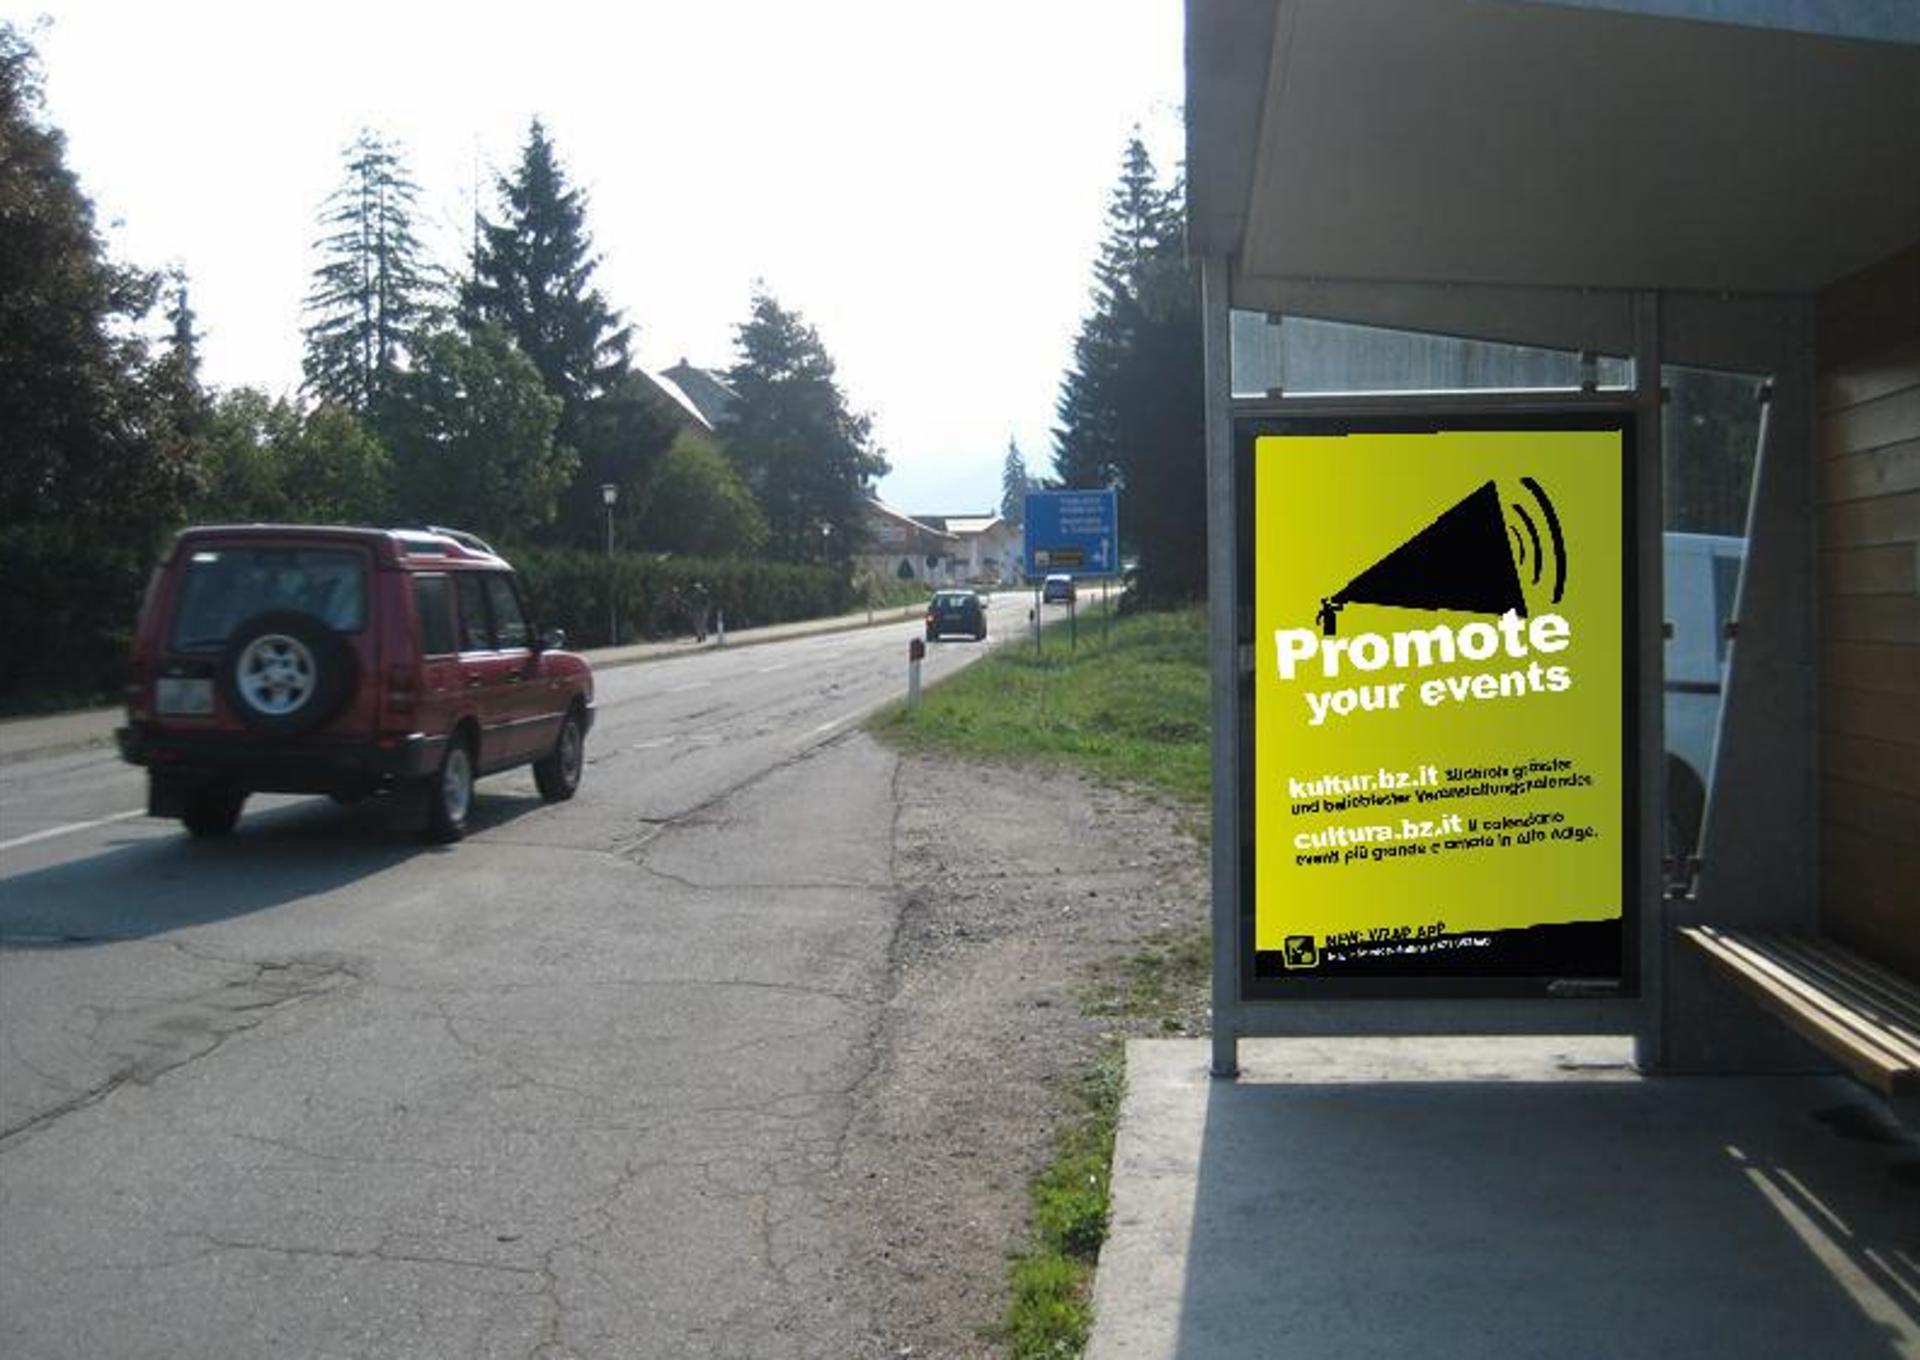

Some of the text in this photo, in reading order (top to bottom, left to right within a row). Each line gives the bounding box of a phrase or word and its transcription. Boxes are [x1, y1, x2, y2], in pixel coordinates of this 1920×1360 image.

[1274, 608, 1571, 680] Promote
[1305, 661, 1572, 726] your events
[1288, 764, 1438, 799] kultur.bz.it
[1291, 800, 1320, 815] und
[1293, 813, 1463, 850] cultura.bz.it
[1345, 846, 1368, 865] più
[1371, 843, 1426, 862] grande
